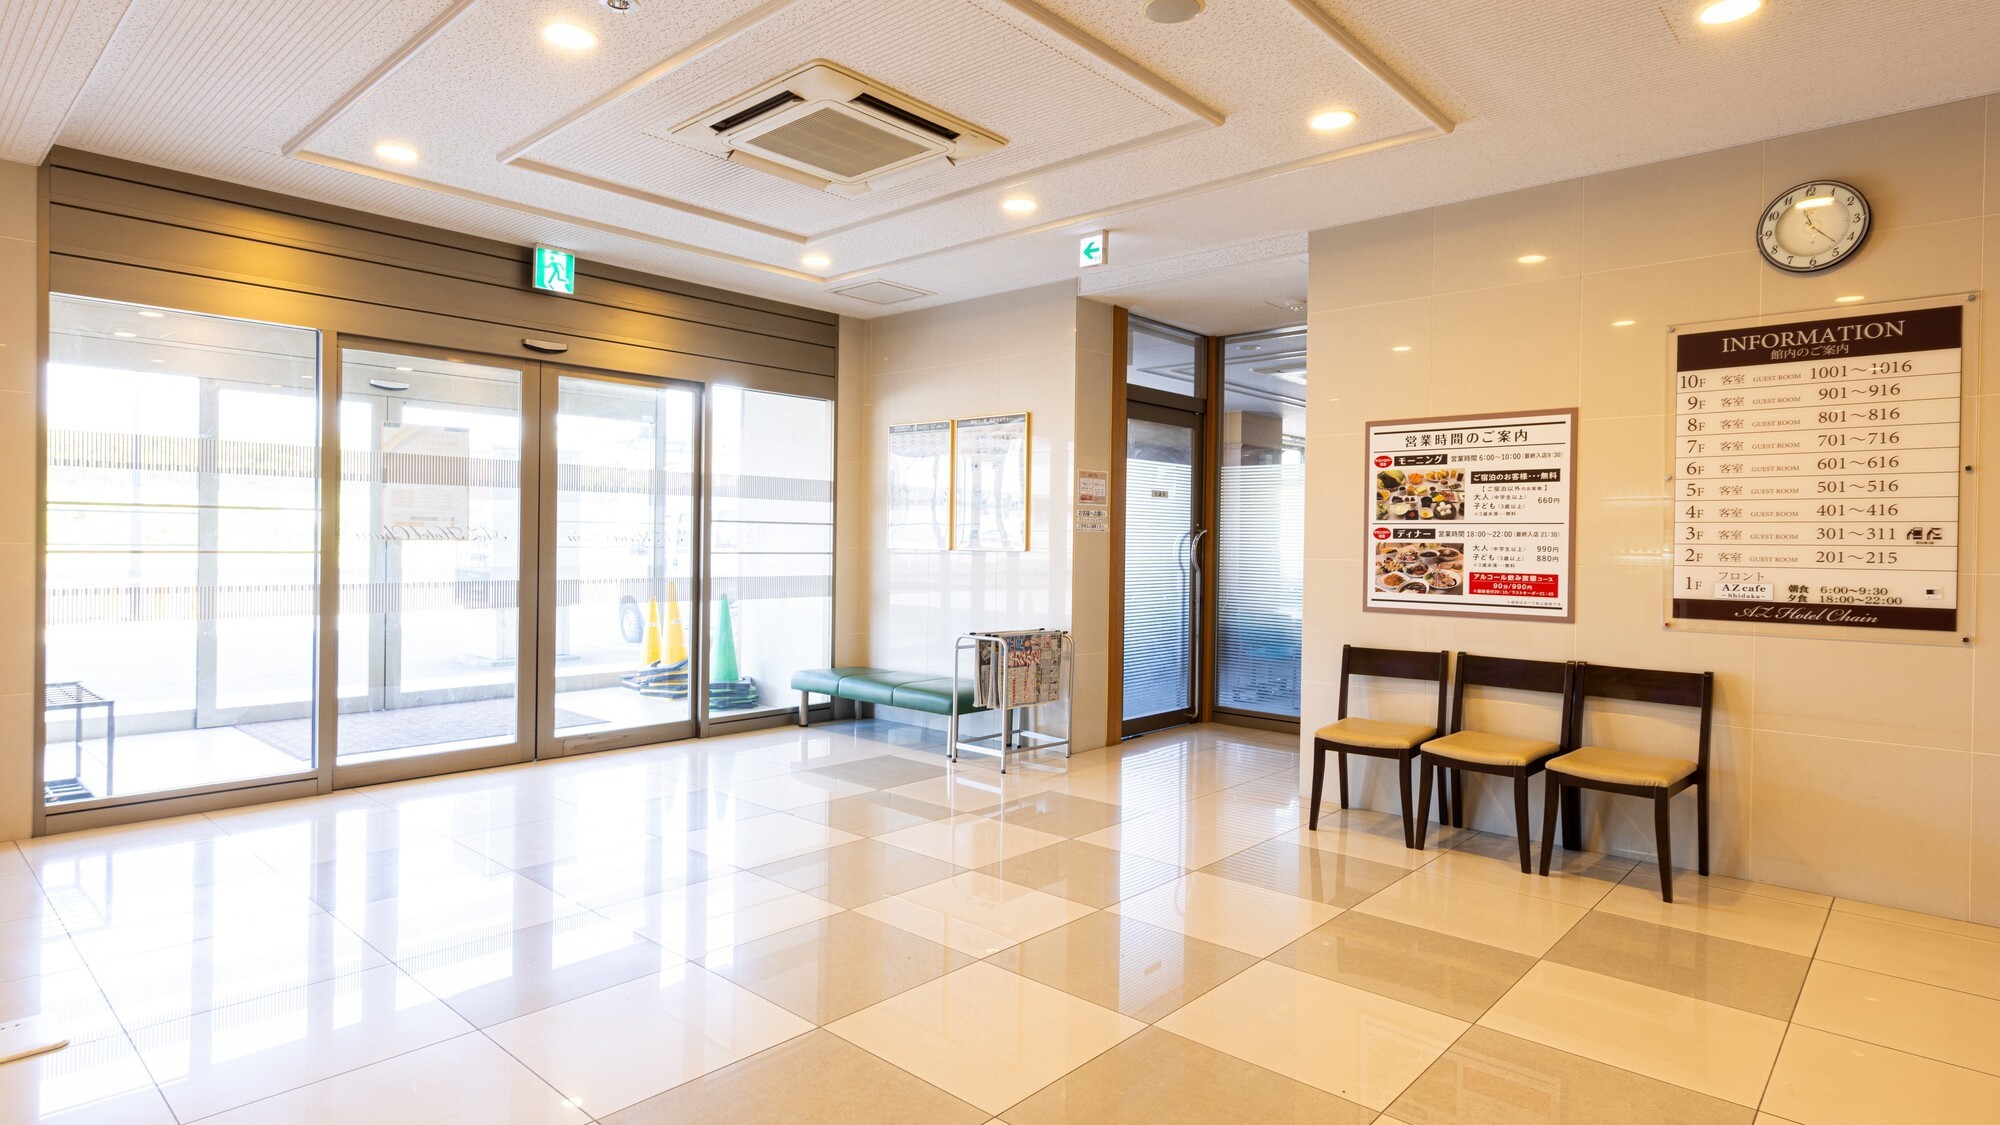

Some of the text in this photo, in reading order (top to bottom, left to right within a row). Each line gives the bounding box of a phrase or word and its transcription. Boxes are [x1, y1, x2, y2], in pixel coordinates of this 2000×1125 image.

[1805, 186, 1817, 197] 12
[1830, 187, 1836, 196] 1
[1784, 195, 1793, 205] 11
[1847, 196, 1855, 206] 2
[1768, 211, 1780, 221] 10
[1853, 213, 1861, 223] 3
[1765, 230, 1773, 240] 9
[1847, 231, 1855, 241] 4
[1771, 245, 1778, 254] 8
[1832, 247, 1839, 257] 5
[1787, 255, 1794, 264] 7
[1809, 256, 1817, 266] 6
[1721, 320, 1906, 353] INFORMATION
[1770, 344, 1850, 360] 館内のご案内
[1681, 374, 1706, 389] 10F
[1721, 374, 1746, 385] 客室
[1688, 396, 1706, 410] 9F
[1720, 397, 1745, 407] 客室
[1687, 418, 1706, 431] 8F
[1720, 419, 1744, 429] 客室
[1405, 429, 1528, 448] 営業時間のご案内
[1687, 440, 1705, 453] 7F
[1720, 441, 1744, 451] 客室
[1399, 455, 1443, 465] モーニング
[1451, 455, 1478, 463] 営業時間
[1686, 461, 1705, 475] 6F
[1720, 463, 1744, 474] 客室
[1686, 483, 1705, 497] 5F
[1719, 485, 1743, 495] 客室
[1537, 497, 1561, 505] 660円
[1685, 505, 1704, 518] 4F
[1719, 508, 1743, 518] 客室
[1397, 529, 1432, 539] ディナー
[1438, 530, 1465, 538] 営業時間
[1685, 526, 1704, 540] 3F
[1718, 530, 1742, 540] 客室
[1536, 545, 1560, 553] 990円
[1685, 548, 1703, 562] 2F
[1718, 552, 1742, 562] 客室
[1473, 573, 1554, 583] アルコール飲み放題コース
[1718, 572, 1764, 581] フロント
[1686, 577, 1702, 590] 1F
[1788, 585, 1809, 594] 朝食
[1787, 594, 1808, 603] 夕食
[1734, 606, 1879, 623] AZ Hotel Chain
